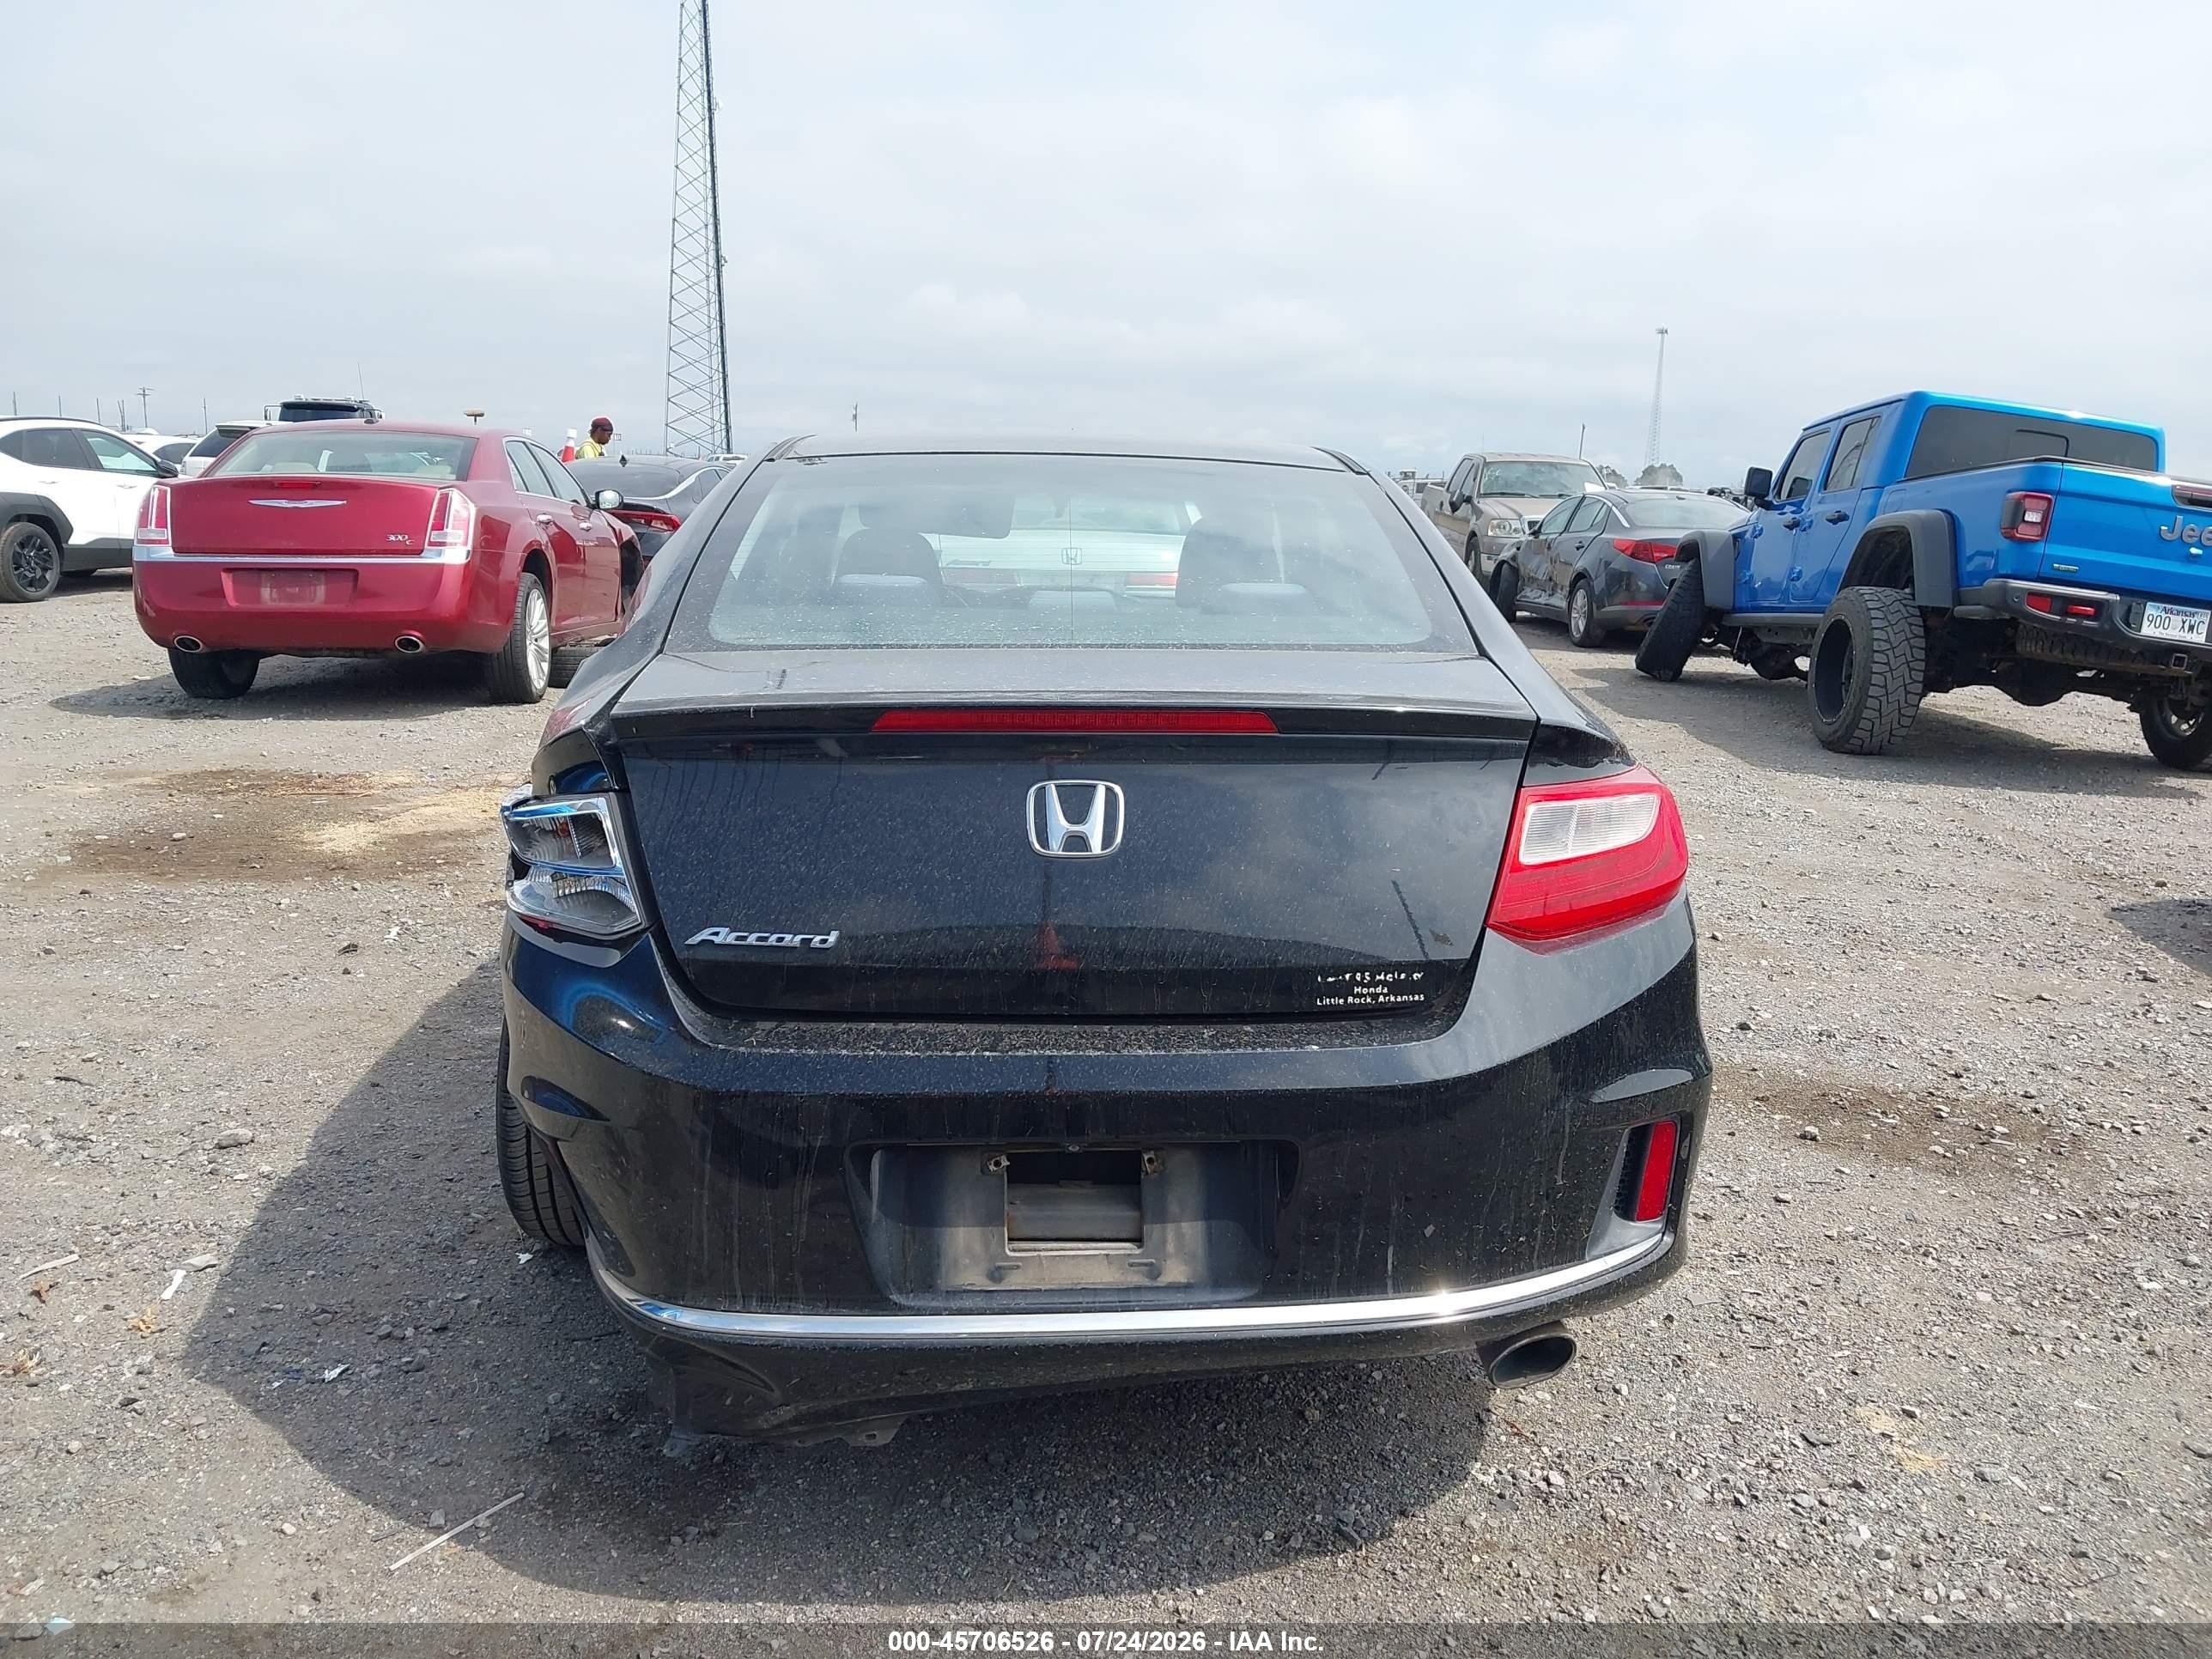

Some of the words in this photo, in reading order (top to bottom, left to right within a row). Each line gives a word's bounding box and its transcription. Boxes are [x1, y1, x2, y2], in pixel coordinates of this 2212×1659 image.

[2160, 515, 2212, 547] Jee
[2160, 606, 2197, 618] Arkansas
[2147, 613, 2172, 631] 900
[2179, 618, 2206, 635] XWC
[684, 927, 840, 949] Accord
[1353, 985, 1389, 994] Honda
[1317, 996, 1345, 1006] Little
[1347, 995, 1376, 1005] Rock,
[1378, 994, 1425, 1003] Arkansas
